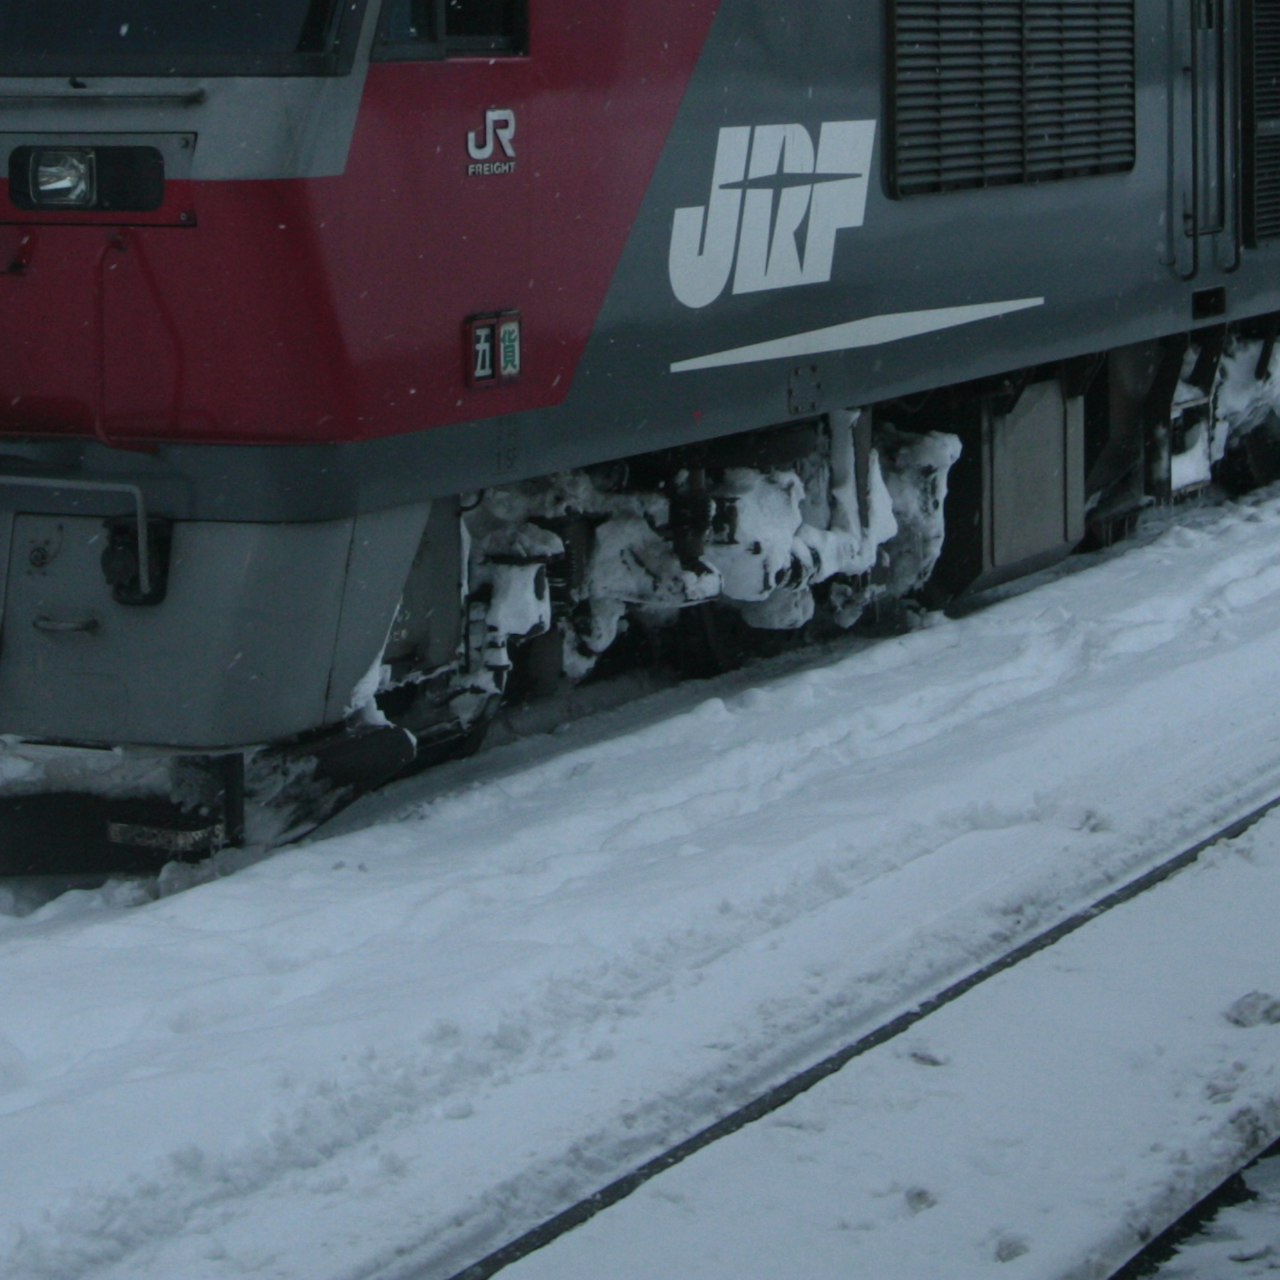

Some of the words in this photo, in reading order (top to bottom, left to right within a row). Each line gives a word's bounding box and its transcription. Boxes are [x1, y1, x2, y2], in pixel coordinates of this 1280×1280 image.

[467, 108, 517, 160] JR
[467, 161, 517, 177] FREIGHT
[668, 119, 877, 310] JRF
